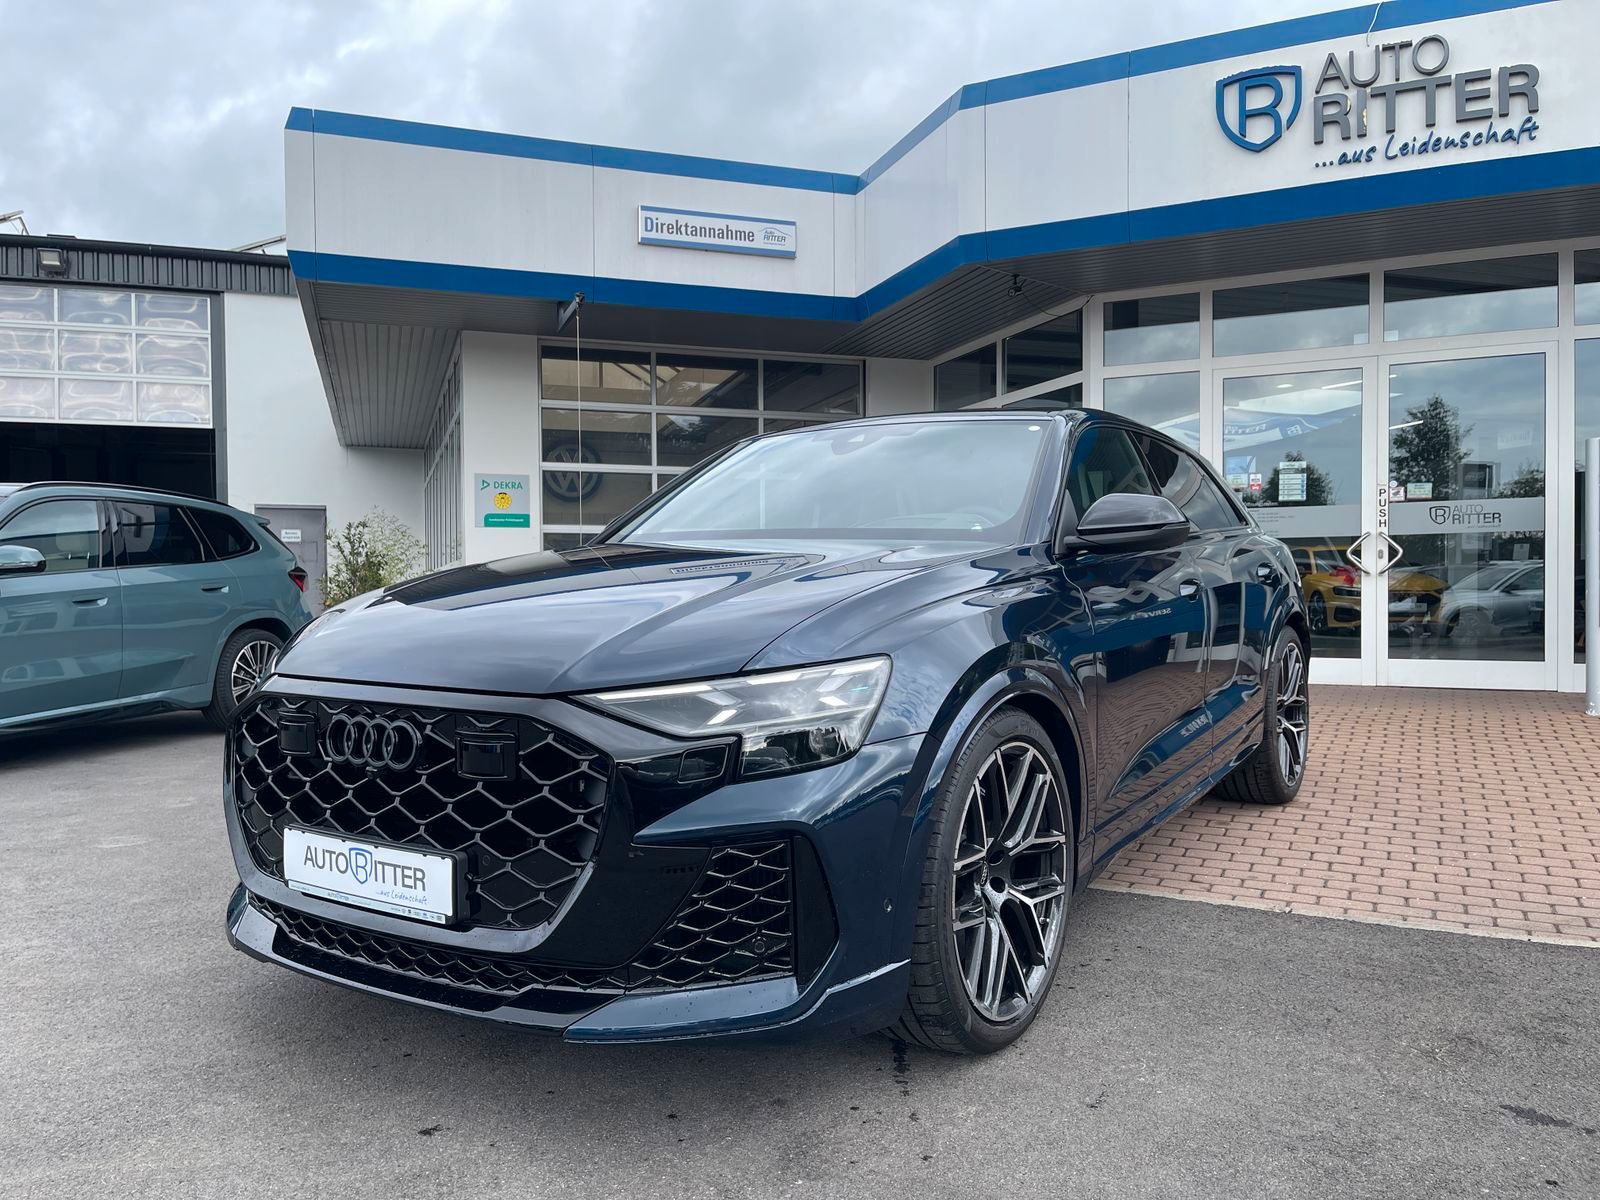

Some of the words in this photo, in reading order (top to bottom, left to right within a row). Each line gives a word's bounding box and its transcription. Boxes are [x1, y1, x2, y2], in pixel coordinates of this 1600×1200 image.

[1315, 34, 1450, 94] AUTO
[1313, 64, 1540, 145] RITTER
[1385, 116, 1540, 161] Leidenschaft
[644, 216, 755, 243] Direktannahme
[493, 481, 523, 490] DEKRA
[1379, 488, 1387, 528] PUSH
[1452, 504, 1484, 514] AUTO
[1452, 512, 1502, 524] RITTER
